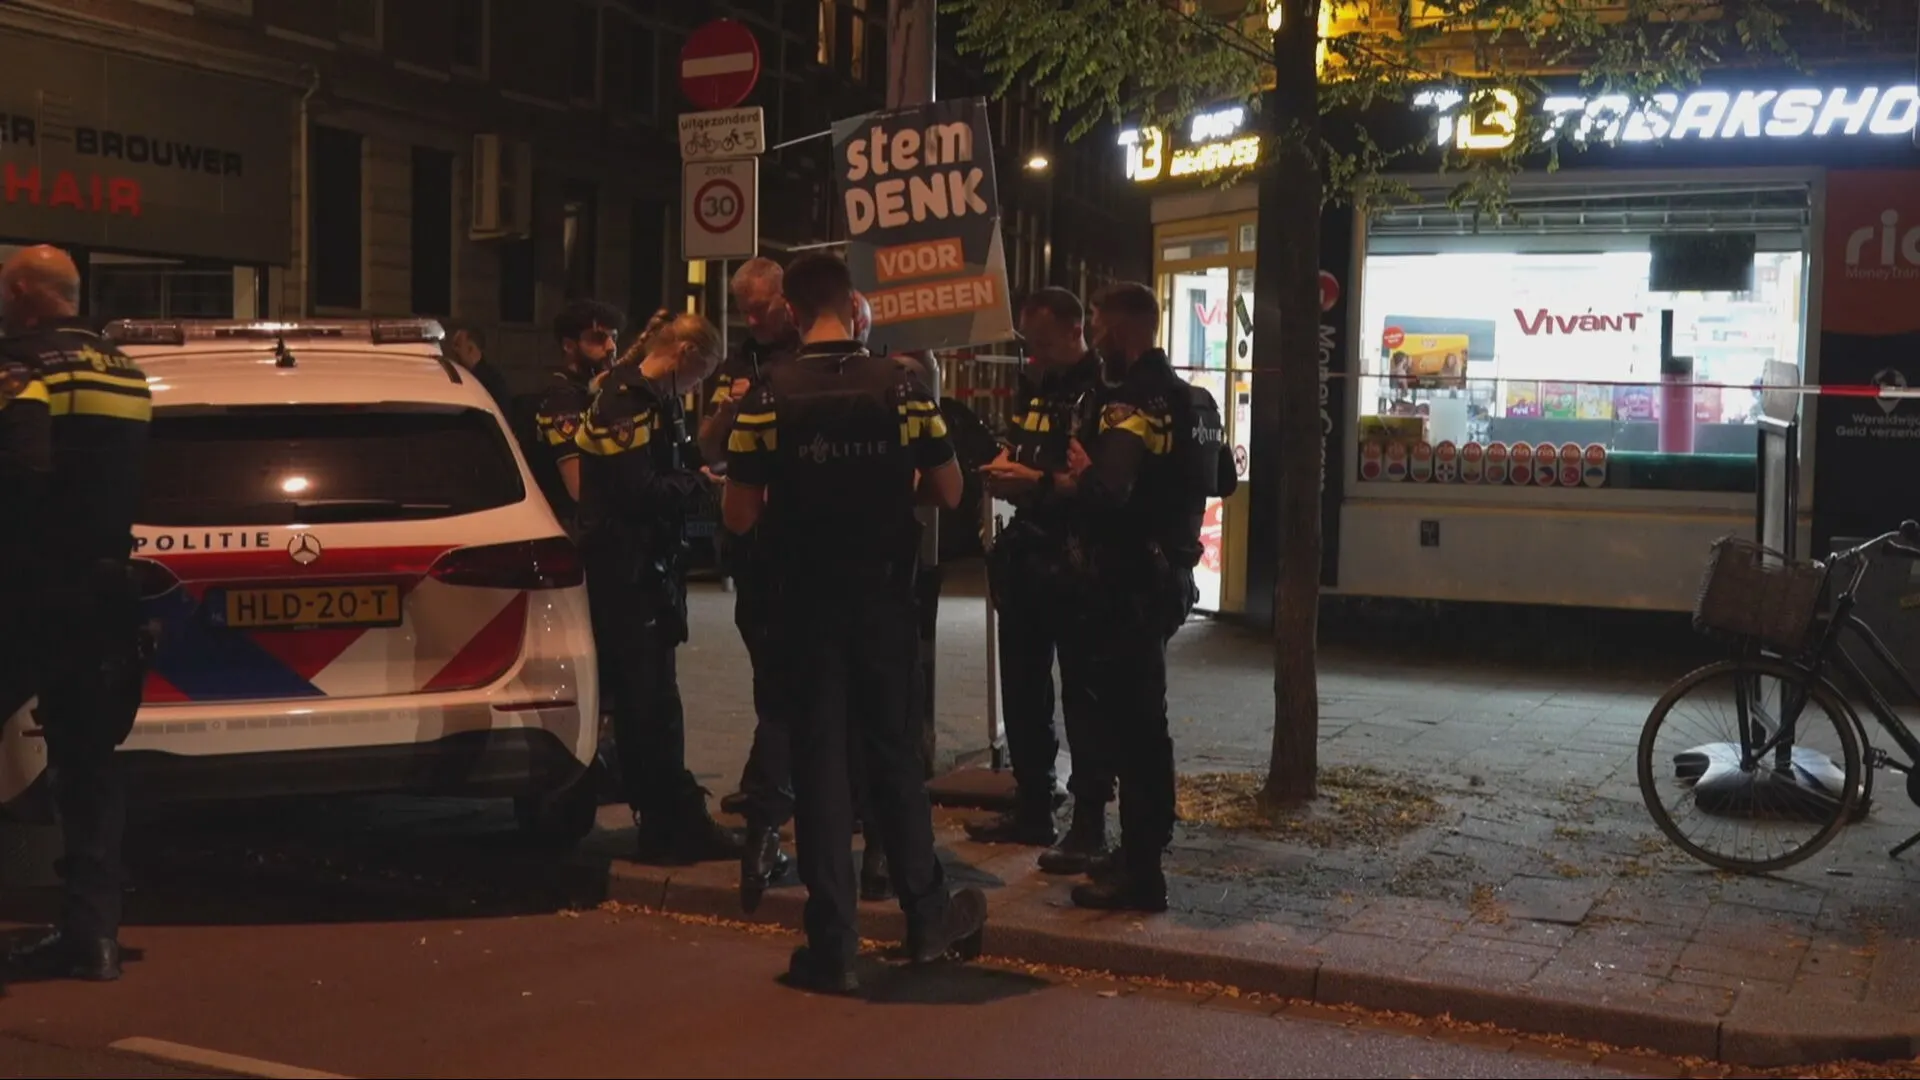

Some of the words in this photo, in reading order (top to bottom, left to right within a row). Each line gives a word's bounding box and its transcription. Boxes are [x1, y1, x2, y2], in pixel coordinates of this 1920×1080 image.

[681, 112, 761, 132] uitgezonderd
[75, 126, 243, 177] BROUWER
[846, 121, 973, 182] stem
[704, 165, 735, 177] ZONE
[5, 163, 141, 216] HAIR
[845, 168, 988, 236] DENK
[704, 195, 735, 218] 30
[879, 243, 959, 277] VOOR
[870, 279, 994, 322] EDEREEN
[1836, 425, 1867, 437] Geld
[133, 531, 271, 552] POLITIE
[236, 589, 388, 622] HLD-20-T
